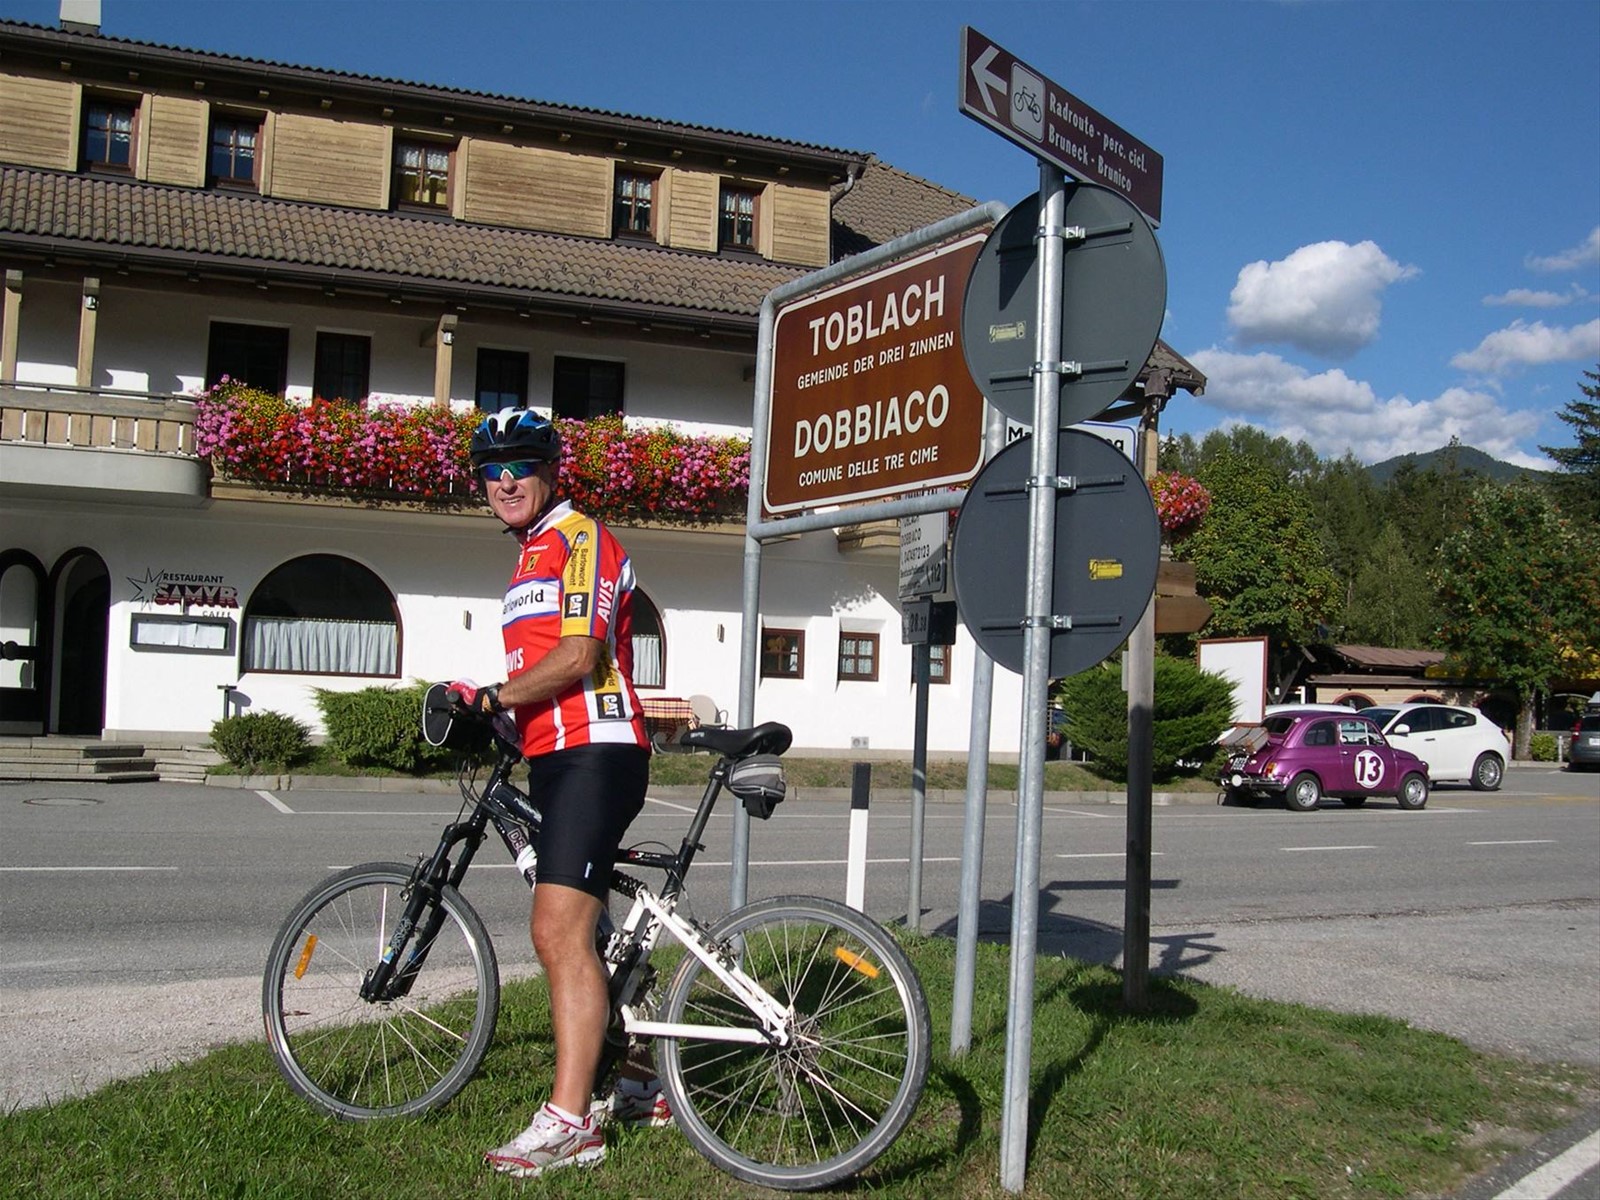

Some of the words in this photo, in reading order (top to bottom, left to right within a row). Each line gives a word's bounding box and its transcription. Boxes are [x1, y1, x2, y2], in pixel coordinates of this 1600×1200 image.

[1049, 92, 1095, 138] Radroute
[1103, 133, 1126, 160] perc.
[1128, 148, 1148, 173] cicl.
[1048, 123, 1089, 166] Bruneck
[1097, 155, 1132, 192] Brunico
[809, 275, 945, 356] TOBLACH
[797, 362, 849, 390] GEMEINDE
[853, 355, 875, 374] DER
[879, 345, 905, 366] DREI
[909, 331, 954, 358] ZINNEN
[794, 384, 950, 458] DOBBIACO
[799, 465, 843, 487] COMUNE
[848, 458, 879, 478] DELLE
[885, 453, 904, 471] TRE
[910, 445, 938, 465] CIME
[162, 573, 224, 584] RESTAURANT
[597, 576, 615, 624] AVIS
[568, 594, 584, 617] CAT
[602, 694, 620, 718] CAT
[1358, 756, 1381, 782] 13
